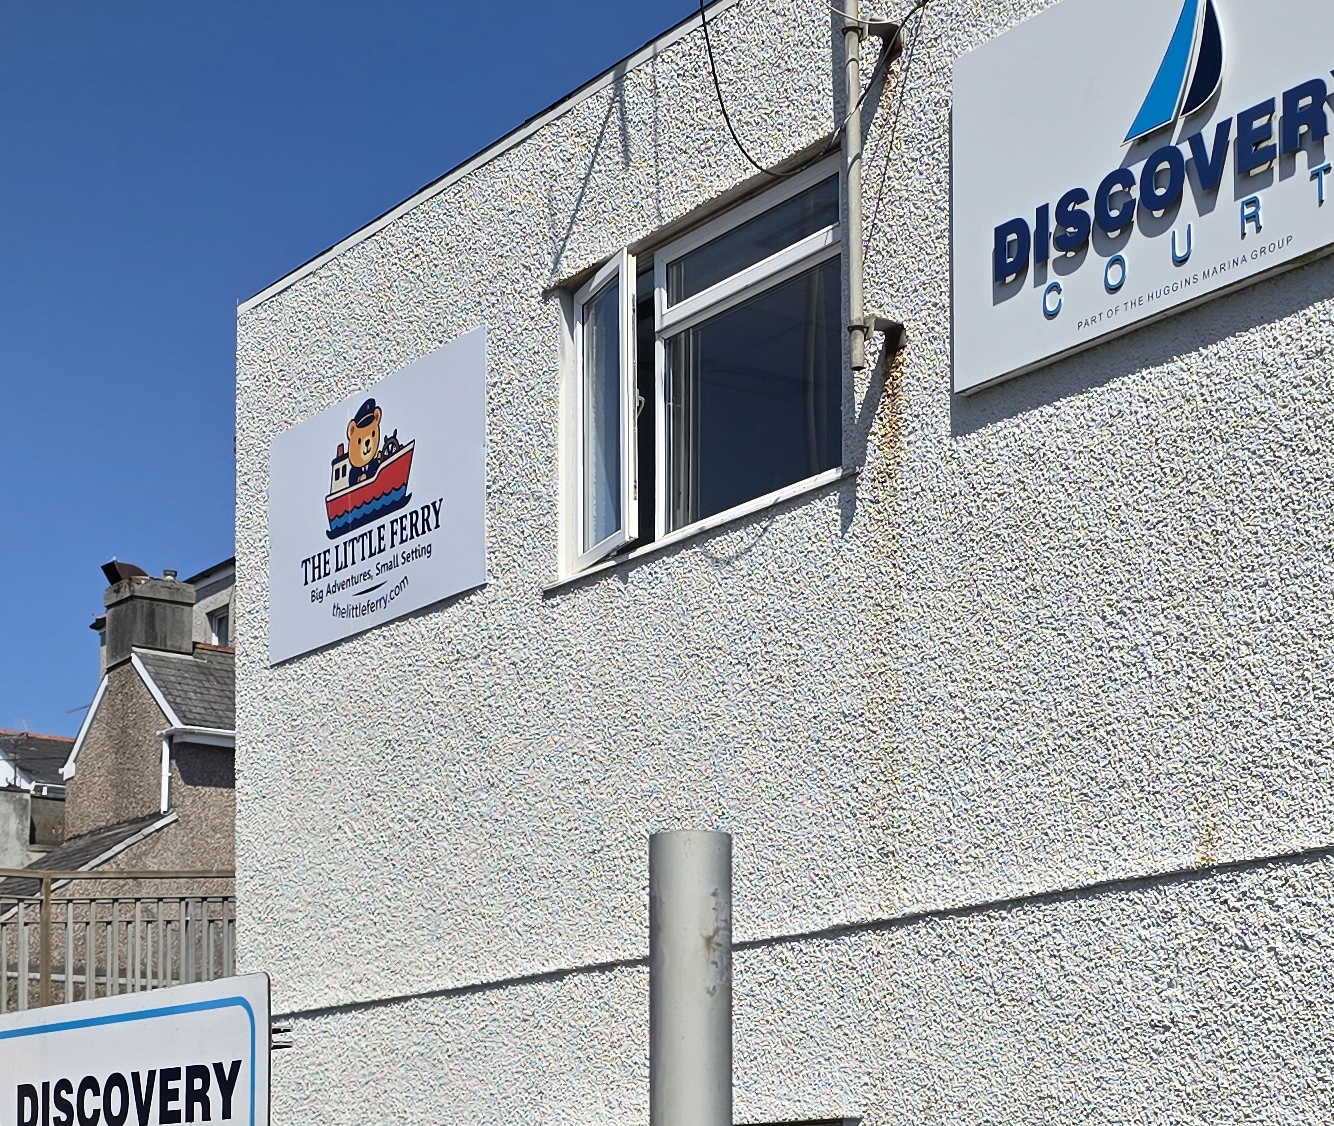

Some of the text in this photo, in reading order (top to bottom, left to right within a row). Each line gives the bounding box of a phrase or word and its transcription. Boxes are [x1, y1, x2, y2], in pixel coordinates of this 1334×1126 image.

[1042, 162, 1332, 320] COURT
[1077, 235, 1294, 331] PART OF THE HUGGINS MARINA GROUP
[301, 498, 444, 587] THE LITTLE FERRY
[310, 543, 432, 603] Big Adventures, Small Setting
[332, 576, 409, 619] thelittleferry.com
